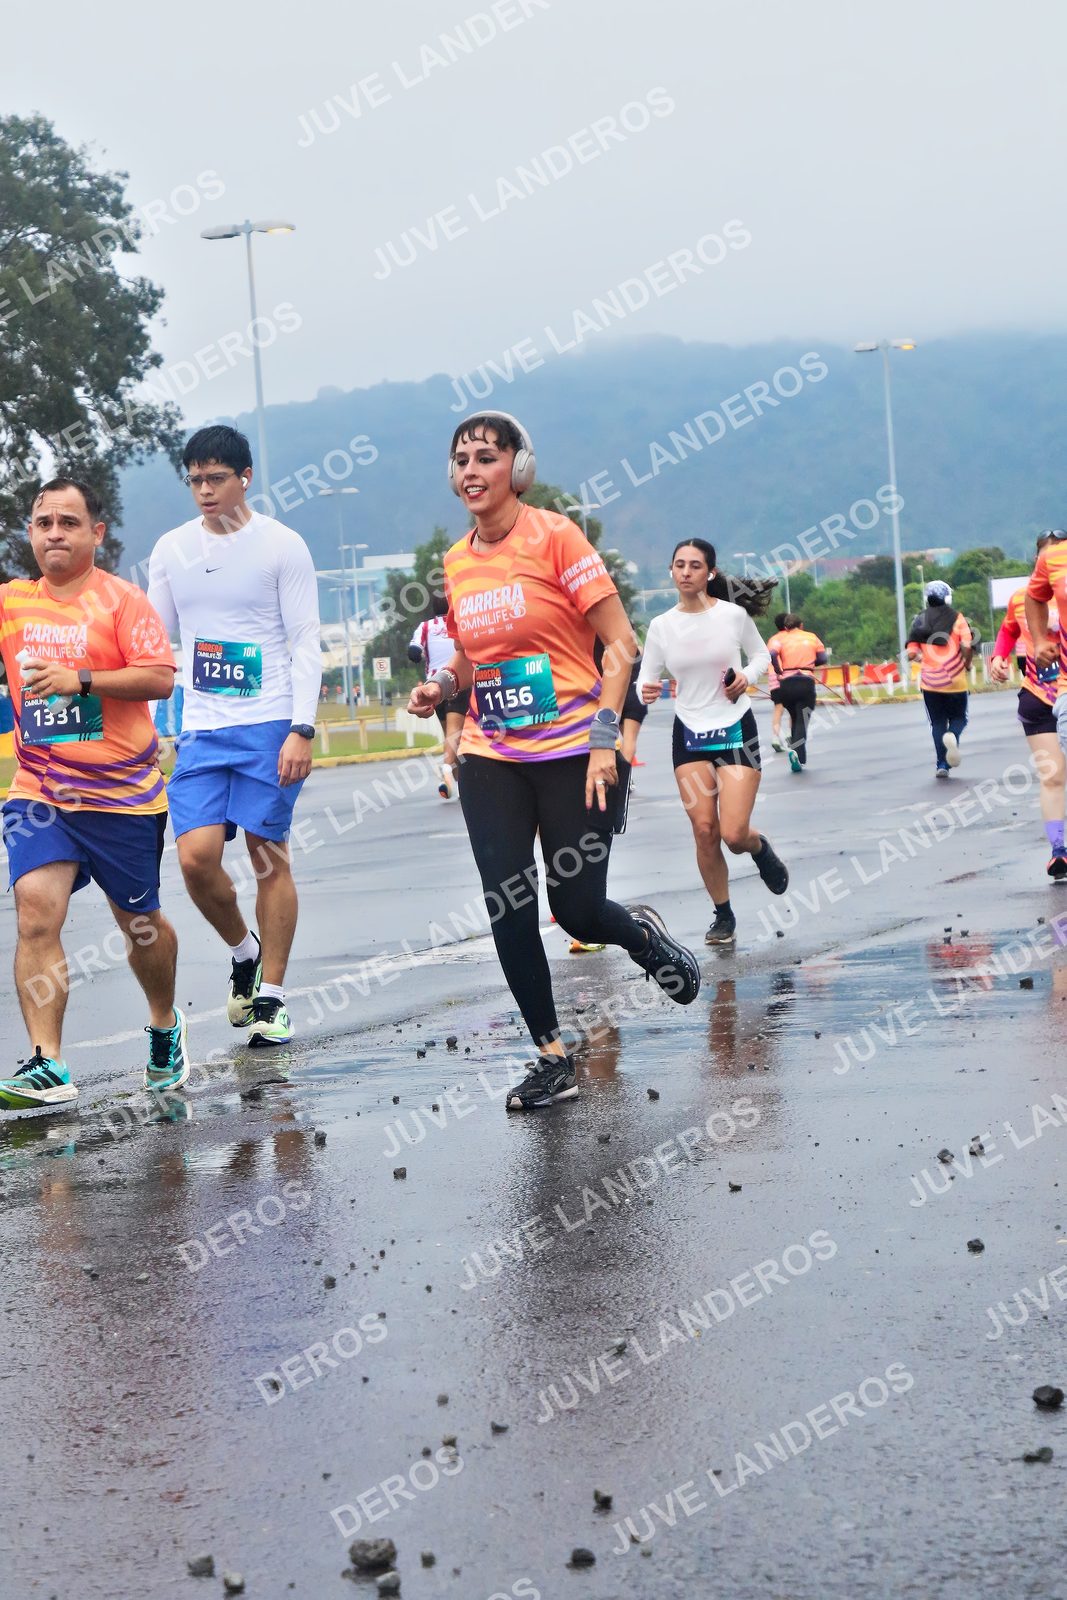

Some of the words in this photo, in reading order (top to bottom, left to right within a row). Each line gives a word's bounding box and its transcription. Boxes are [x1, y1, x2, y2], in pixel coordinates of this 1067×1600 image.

[459, 582, 525, 617] CARRERA
[459, 609, 509, 632] OMNILIFE
[23, 622, 88, 643] CARRERA
[24, 645, 72, 659] OMNILIFE
[243, 646, 257, 657] 10K
[203, 661, 245, 680] 1216
[525, 660, 543, 676] 10K
[484, 685, 534, 711] 1156
[33, 706, 82, 727] 1331
